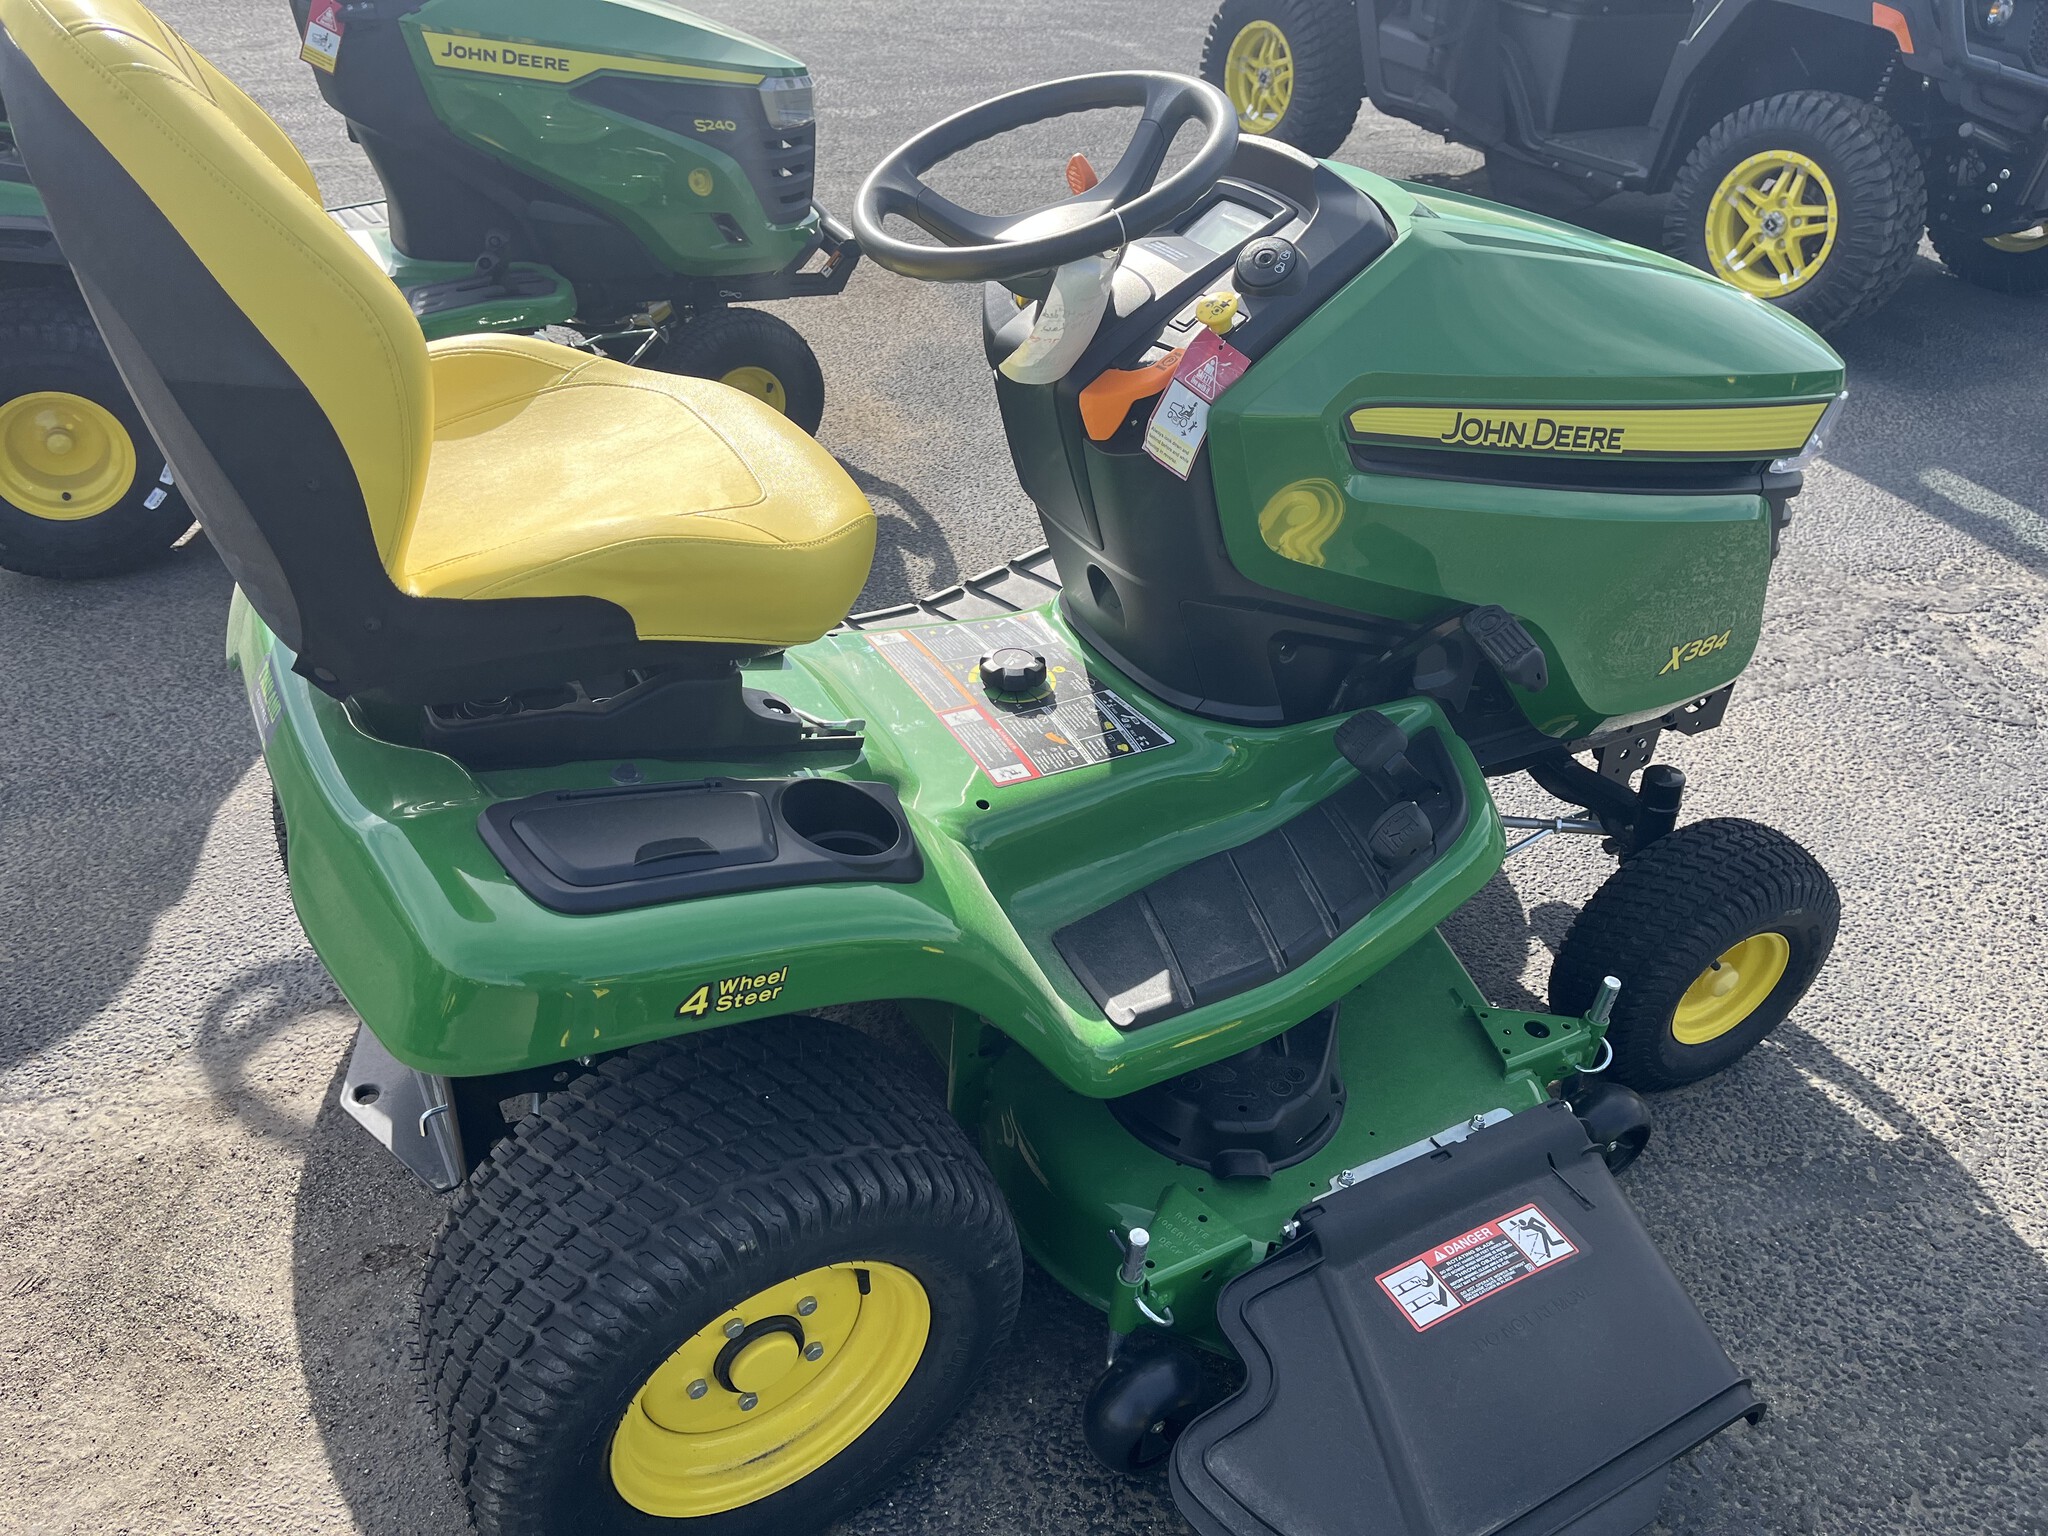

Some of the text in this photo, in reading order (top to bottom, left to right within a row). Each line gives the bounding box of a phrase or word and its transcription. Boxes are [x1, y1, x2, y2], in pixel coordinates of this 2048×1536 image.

[441, 42, 570, 73] JOHN DEERE
[693, 118, 737, 133] S240
[1195, 368, 1214, 385] SAFETY
[1441, 410, 1624, 452] JOHN DEERE
[1658, 628, 1732, 677] X384
[677, 966, 788, 1018] 4 Wheel
[715, 985, 784, 1014] Steer
[1174, 1212, 1210, 1240] ROTATE
[1443, 1227, 1494, 1255] DANGER
[1446, 1240, 1495, 1266] ROTATING BLADE
[1455, 1251, 1507, 1278] THROWN OBJECTS
[1502, 1313, 1538, 1338] NOT
